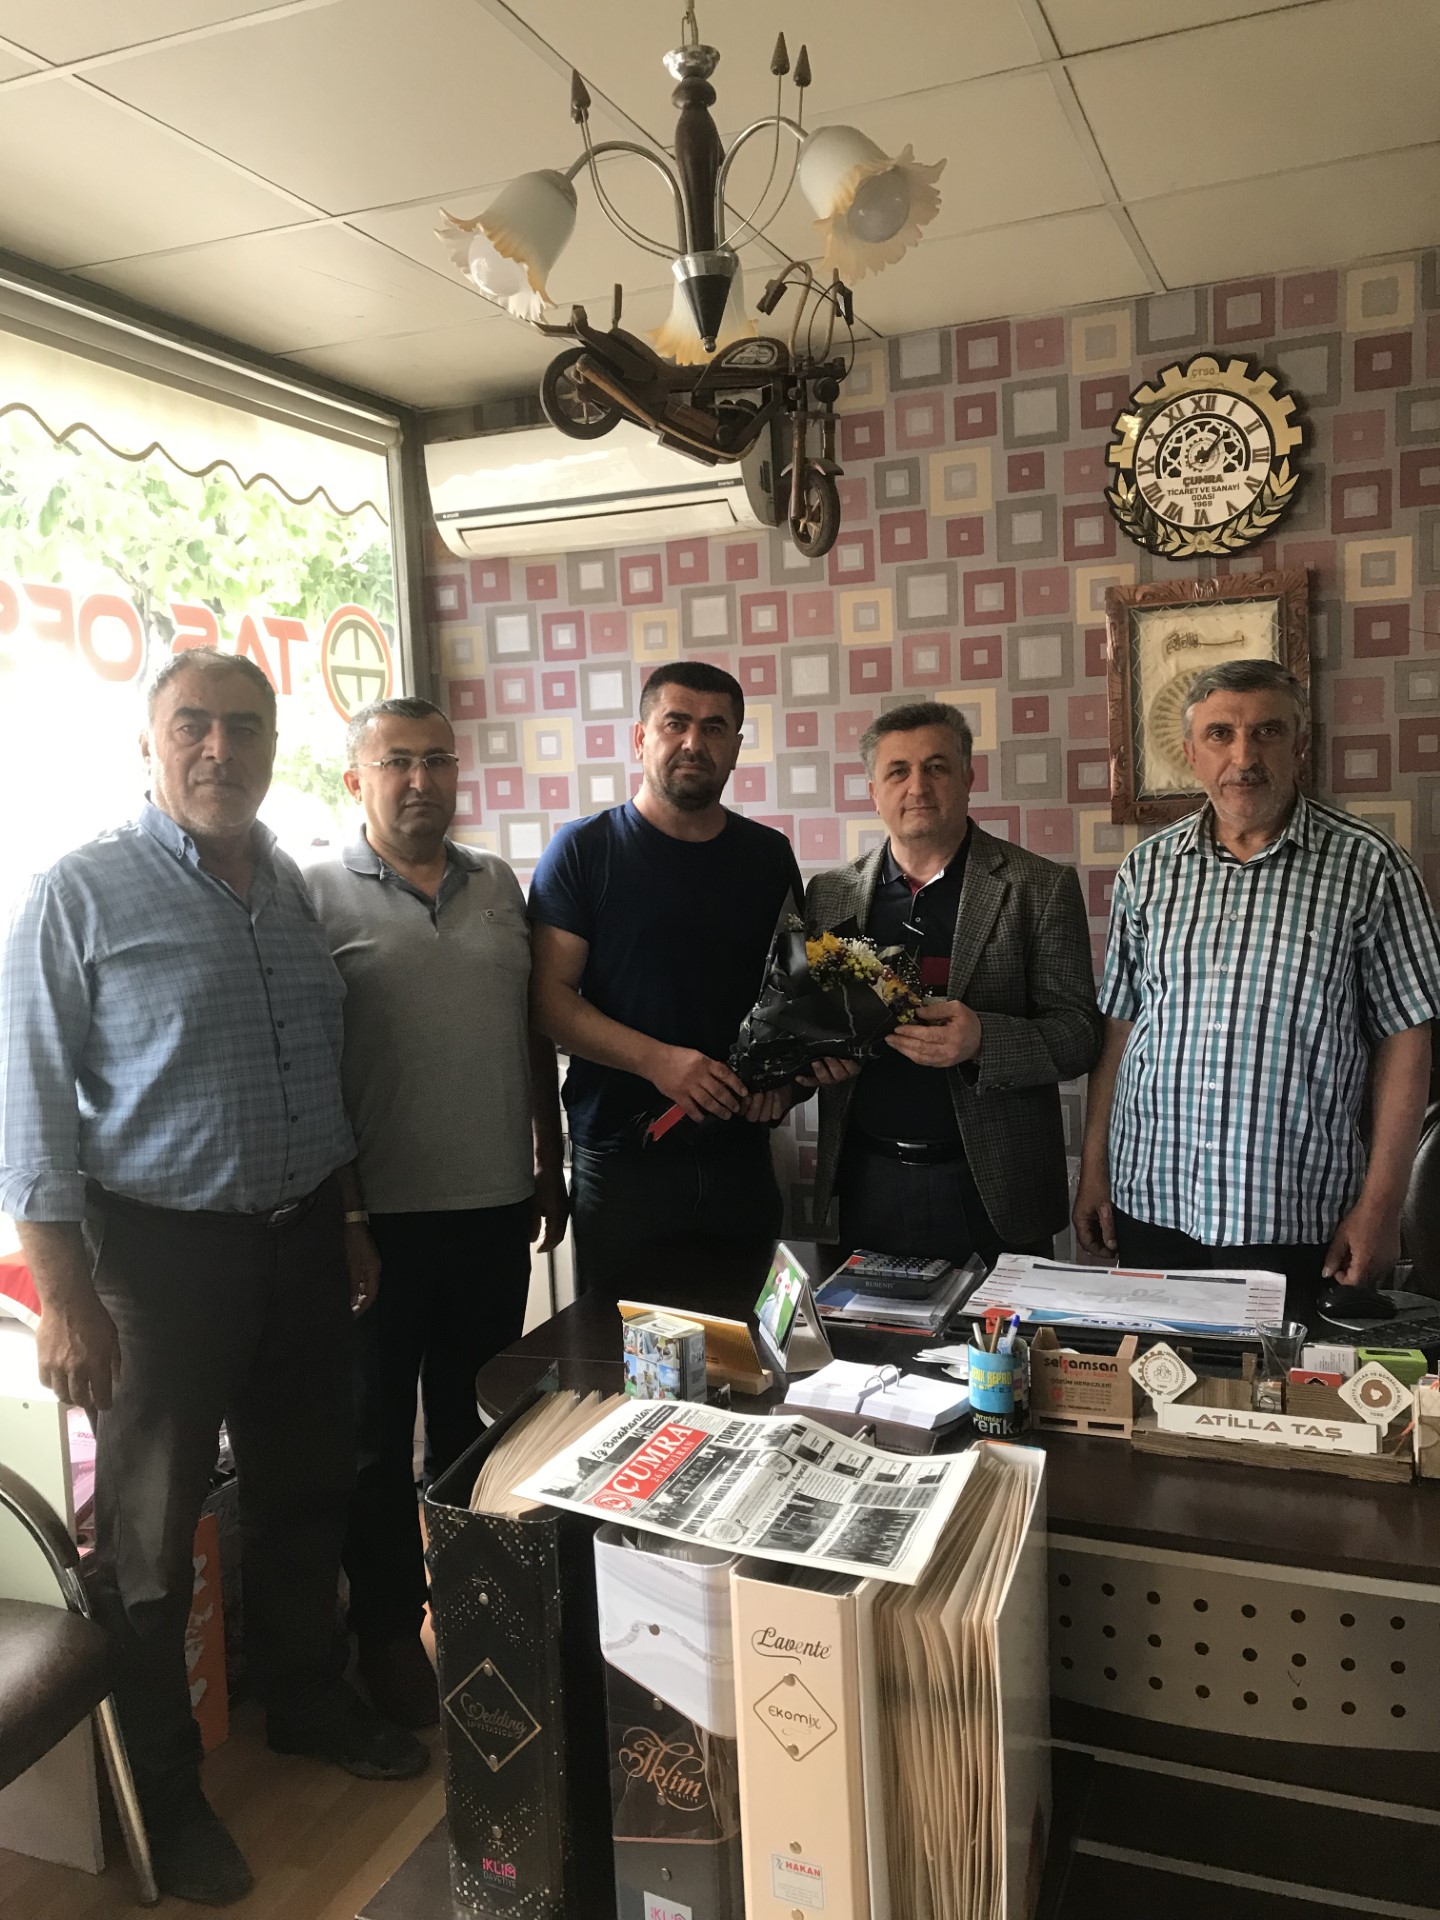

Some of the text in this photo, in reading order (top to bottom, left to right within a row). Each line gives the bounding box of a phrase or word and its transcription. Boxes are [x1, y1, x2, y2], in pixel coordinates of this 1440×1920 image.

[1167, 487, 1199, 496] TİCARET
[1211, 483, 1240, 492] SANAYİ
[1183, 474, 1224, 487] ÇUMRA
[1191, 493, 1215, 501] ODASI
[973, 1416, 1014, 1435] renk
[1195, 1413, 1343, 1442] ATİLLA TAŞ
[612, 1425, 694, 1494] ÇUMRA
[660, 1441, 695, 1474] HAZİRAN
[752, 1627, 832, 1664] Lavente
[785, 1861, 821, 1877] HAKAN
